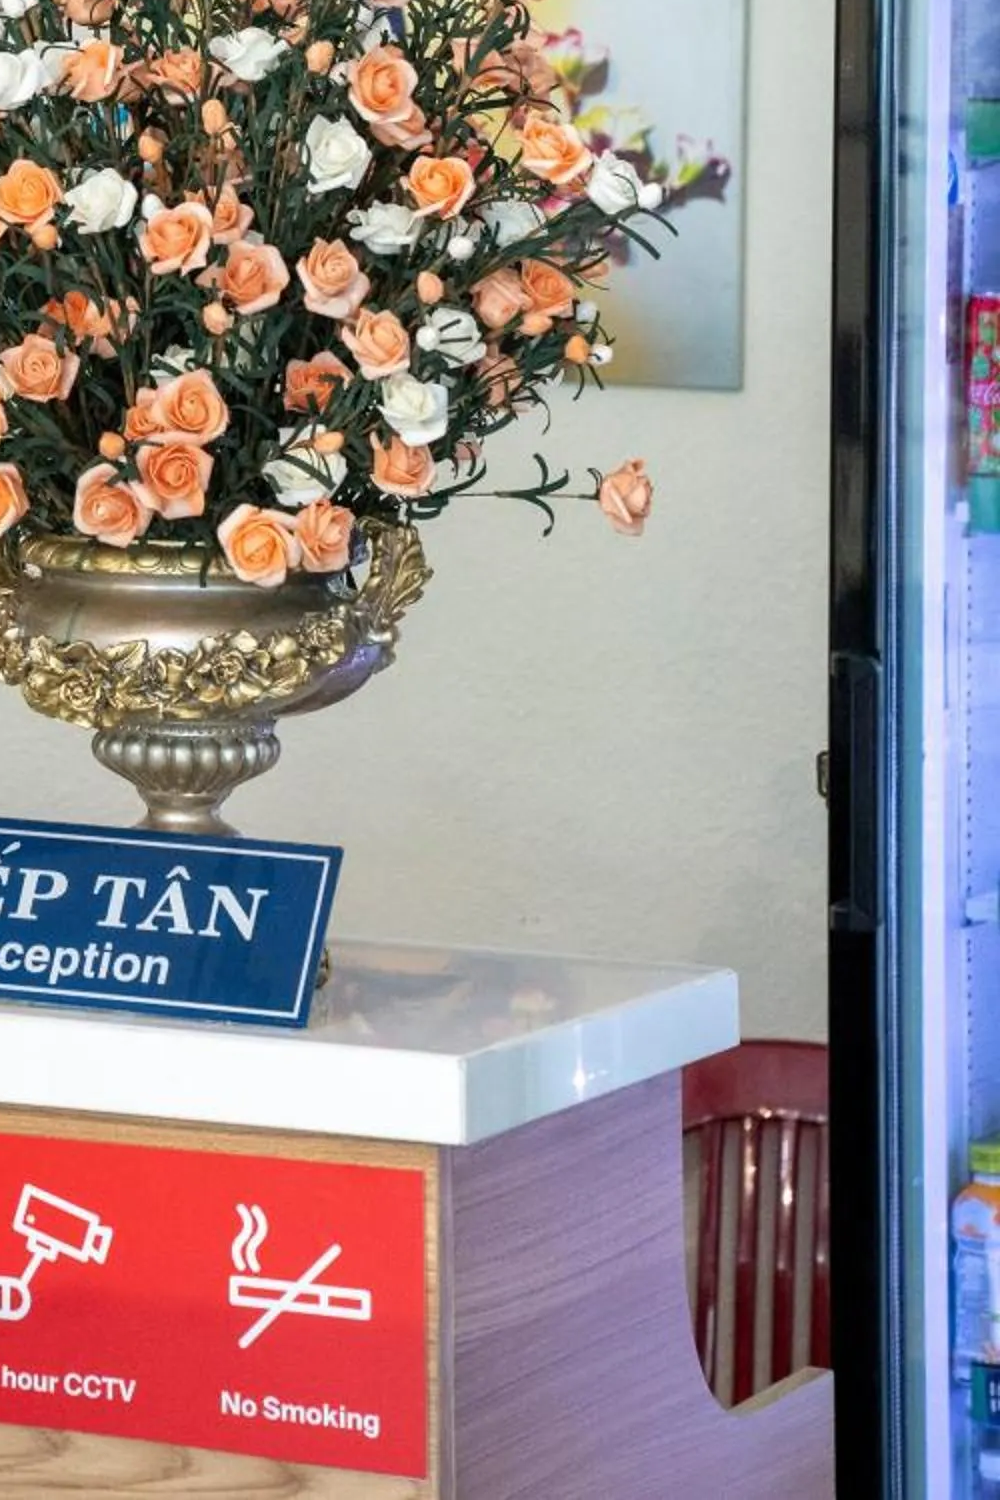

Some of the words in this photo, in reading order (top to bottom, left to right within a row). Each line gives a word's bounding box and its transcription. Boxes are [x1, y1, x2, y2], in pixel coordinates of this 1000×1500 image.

[94, 865, 269, 942] TÂN
[1, 1367, 59, 1396] hour
[63, 1373, 136, 1404] CCTV
[220, 1390, 257, 1418] No
[262, 1396, 380, 1439] Smoking
